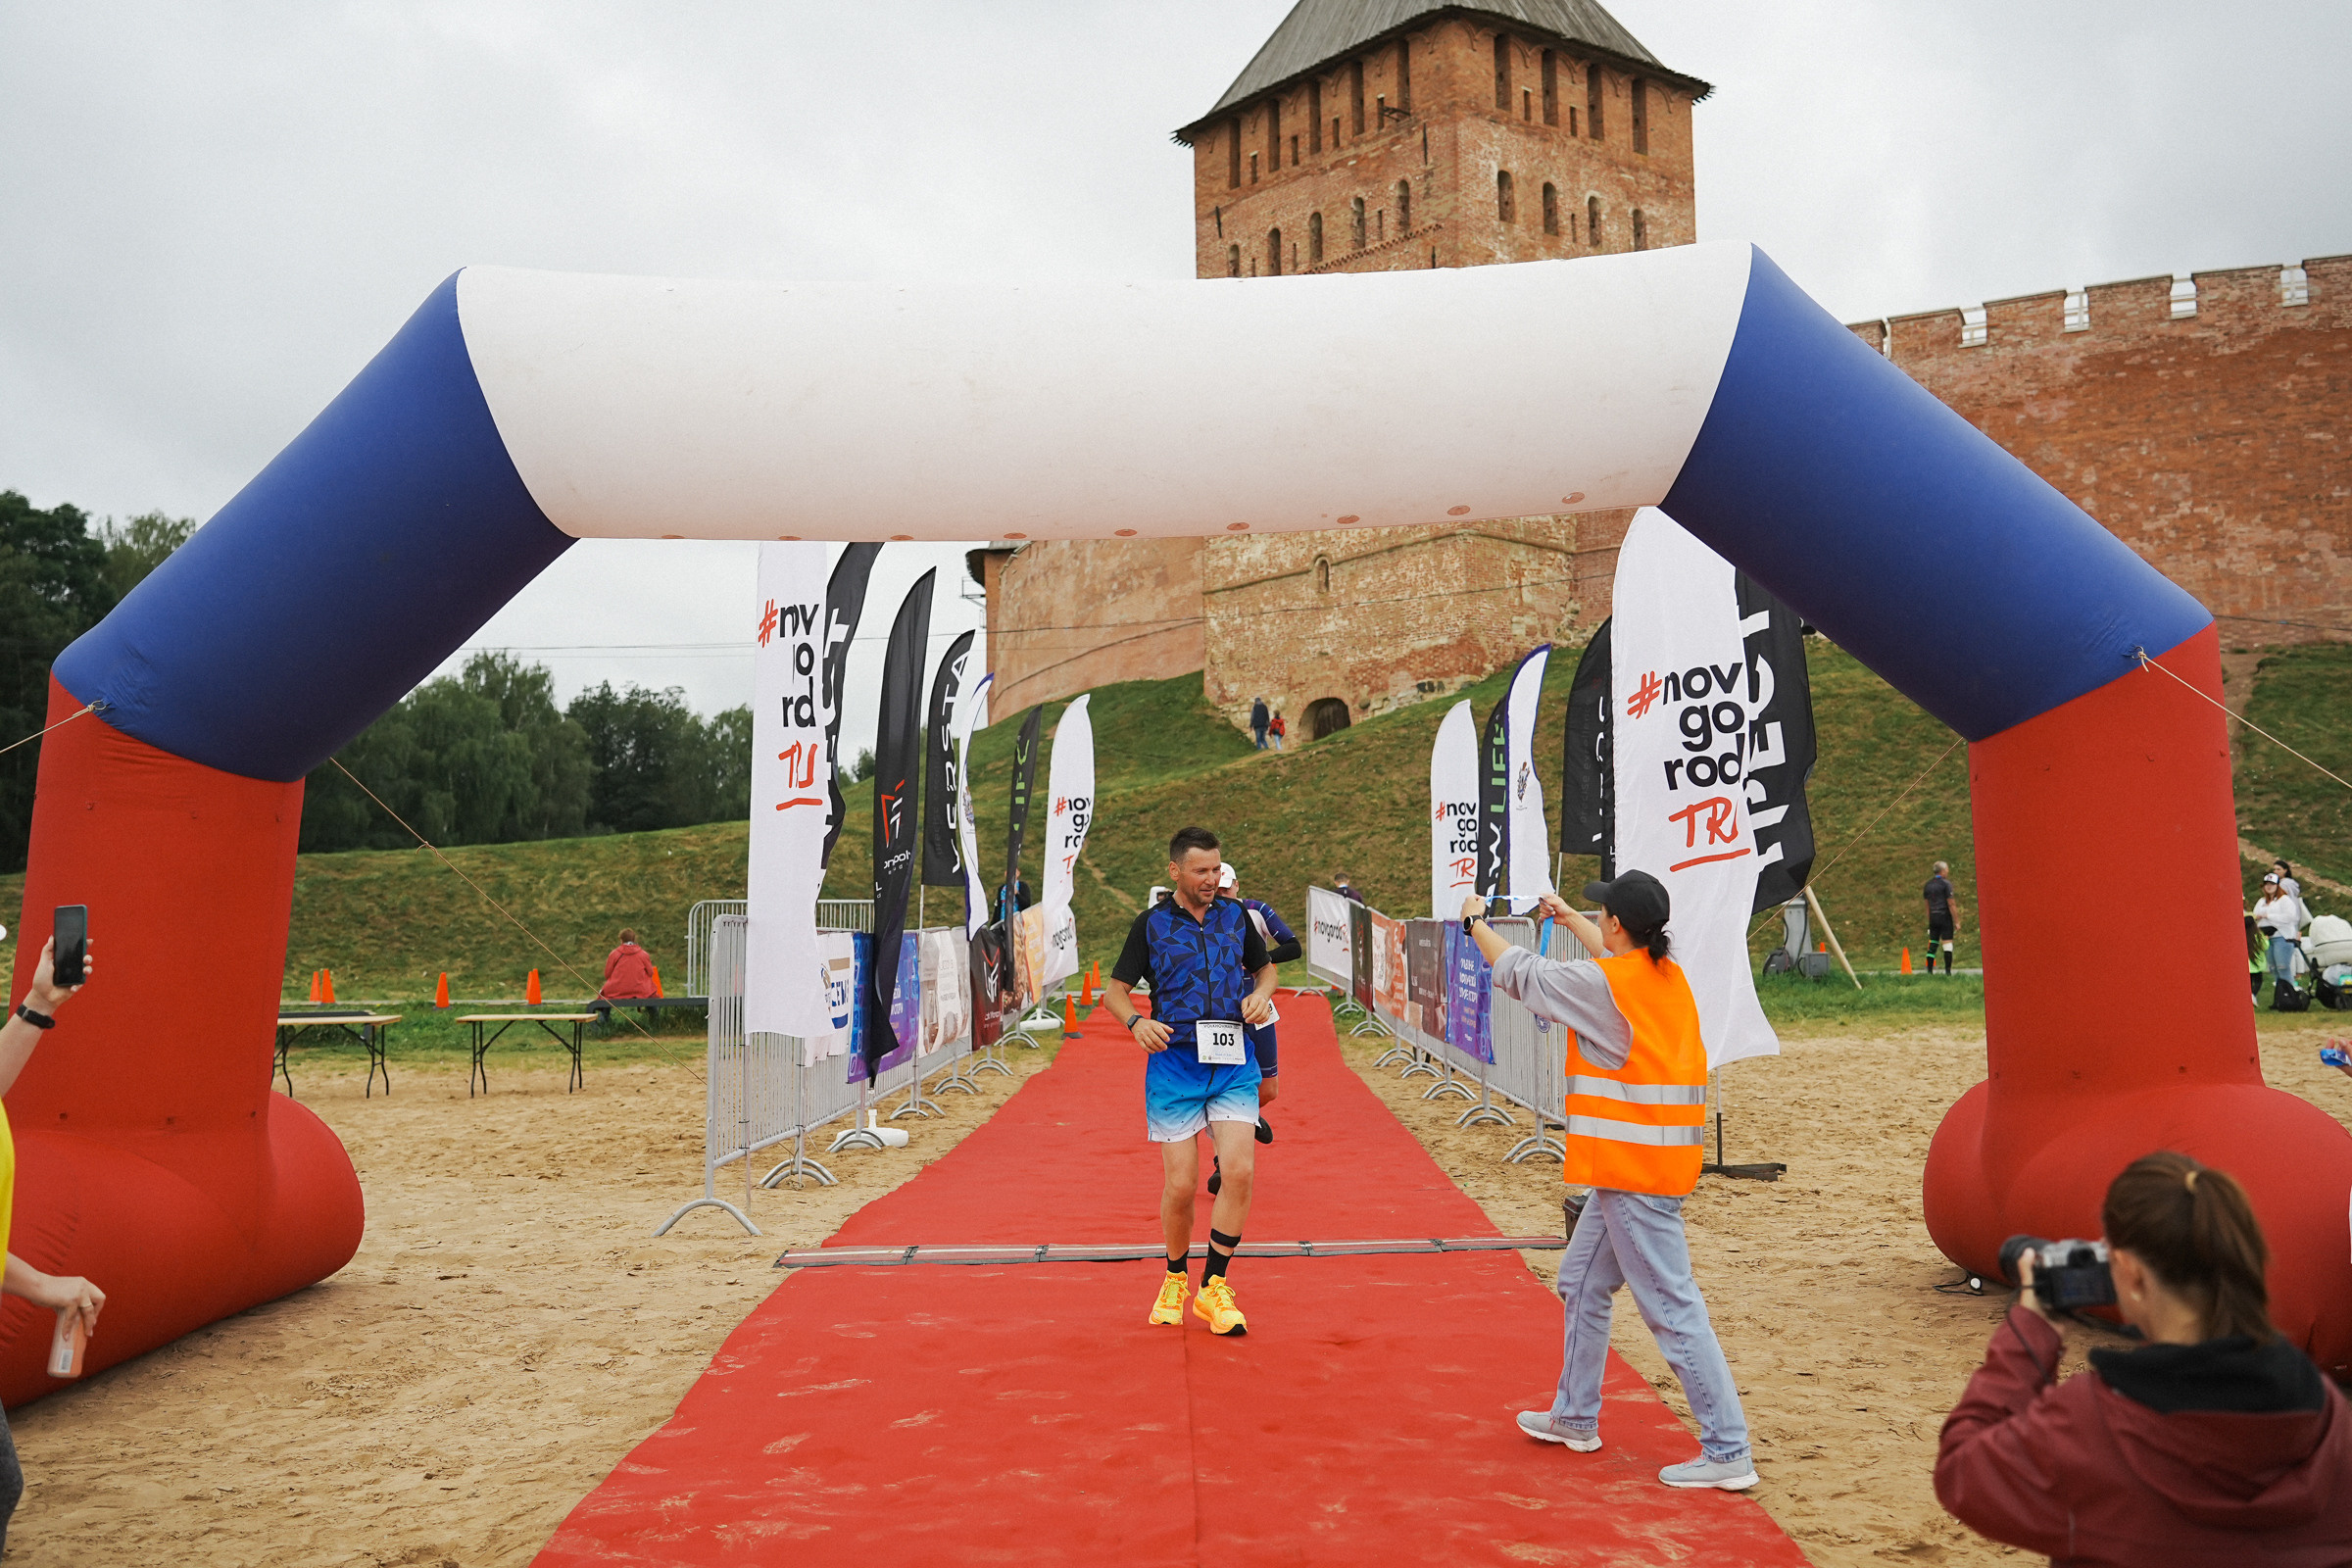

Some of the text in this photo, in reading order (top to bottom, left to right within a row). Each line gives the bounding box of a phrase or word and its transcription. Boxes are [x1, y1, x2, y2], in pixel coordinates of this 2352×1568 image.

[1627, 662, 1743, 719] #nov
[1679, 701, 1745, 752] go
[1663, 733, 1746, 791] rod
[1436, 801, 1477, 822] #nov
[1668, 796, 1739, 848] TR
[1457, 817, 1477, 837] go
[1450, 832, 1478, 854] rod
[1449, 858, 1475, 877] TR
[1212, 1032, 1235, 1047] 103
